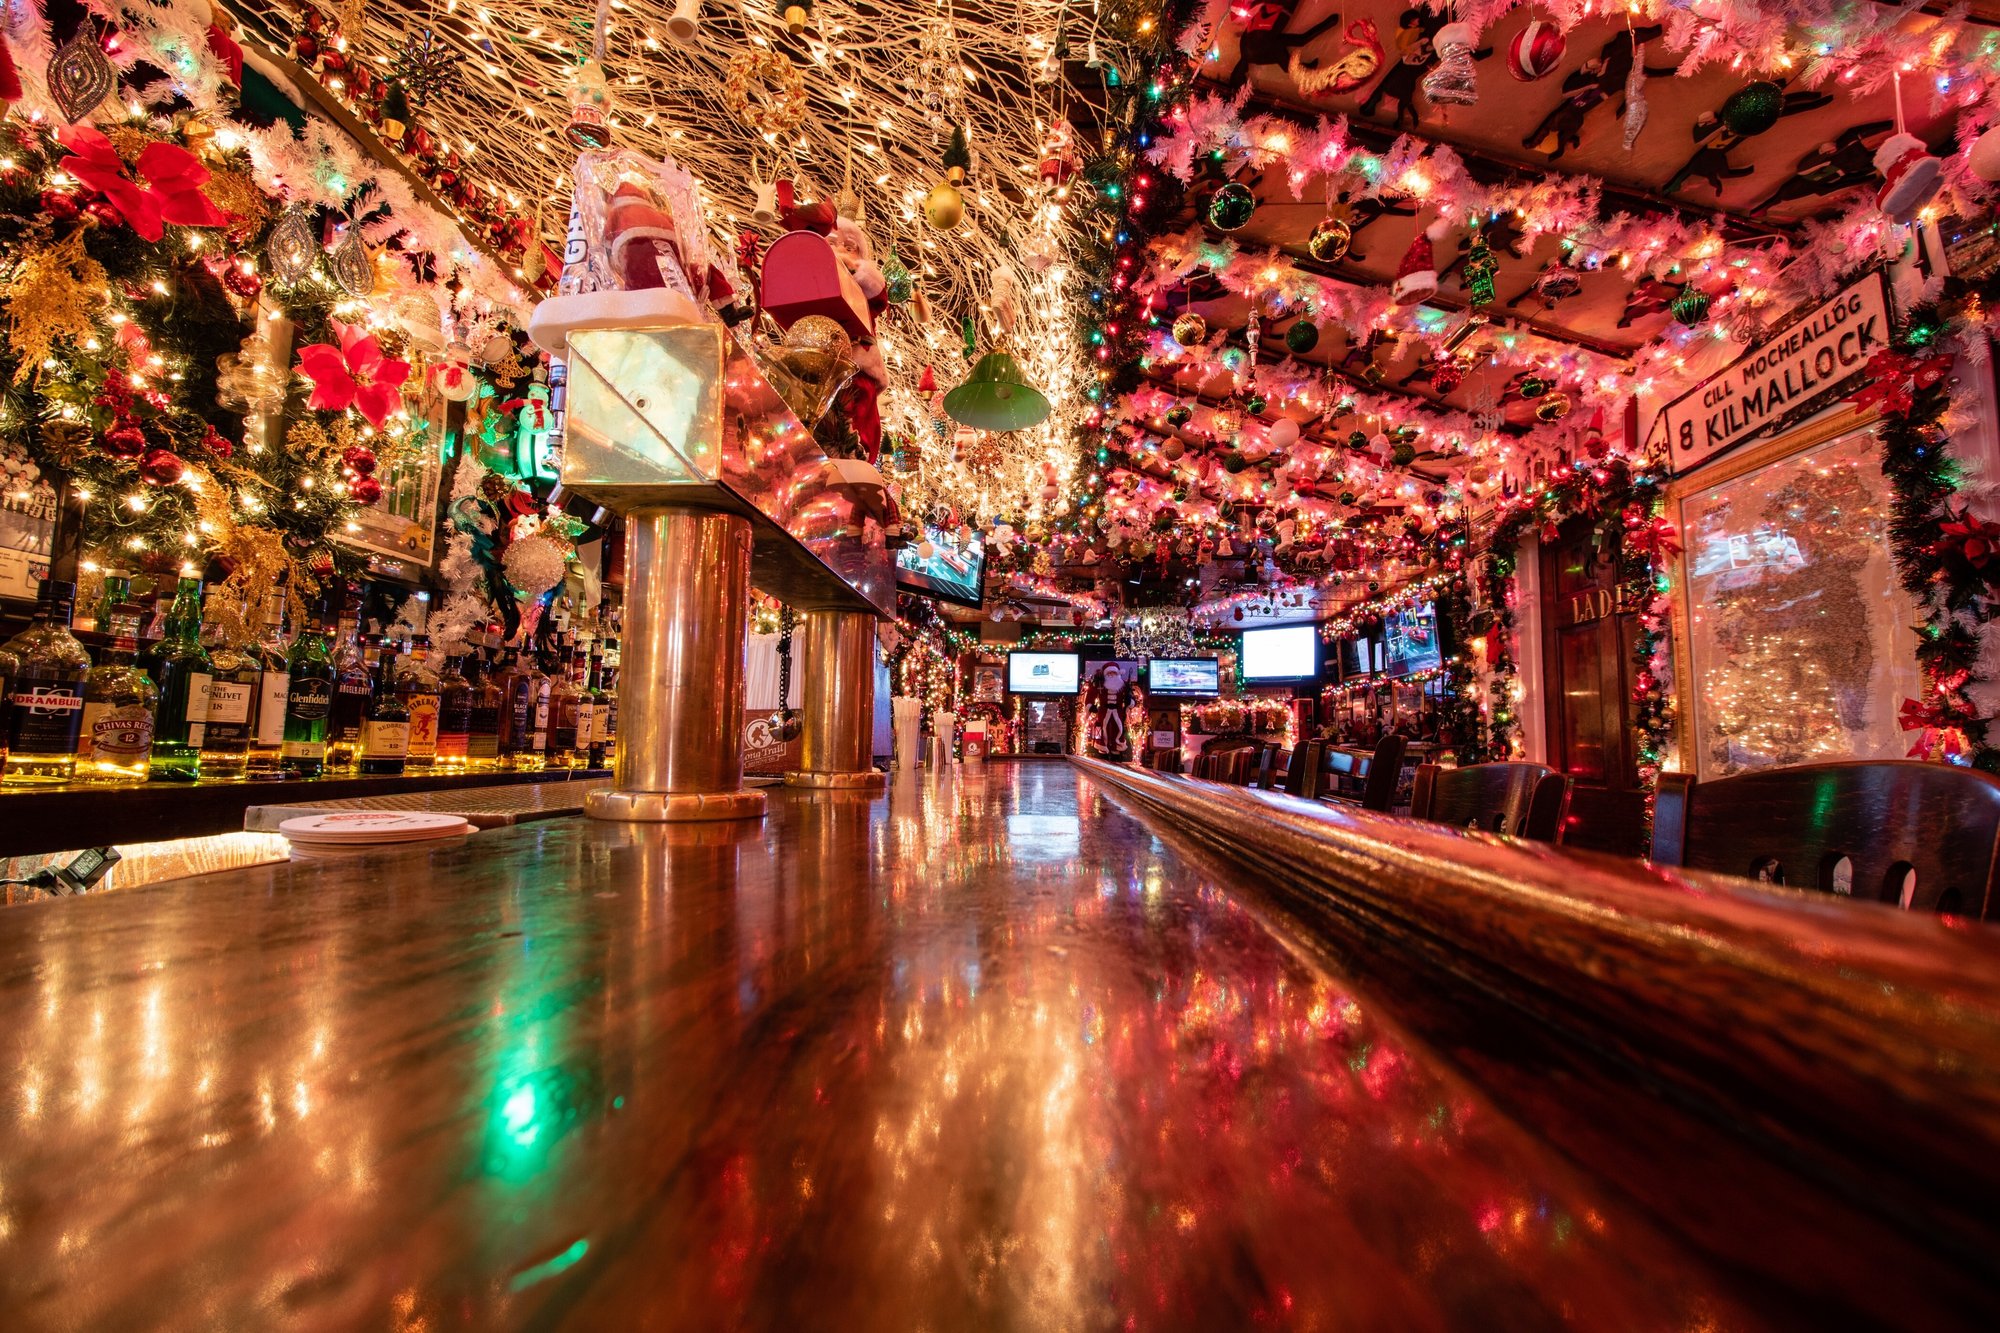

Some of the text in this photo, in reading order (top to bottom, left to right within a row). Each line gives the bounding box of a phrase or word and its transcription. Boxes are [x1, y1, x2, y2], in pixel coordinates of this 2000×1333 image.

[1679, 314, 1878, 451] 8 KILMALLOCK
[1703, 380, 1734, 409] CILL
[16, 695, 81, 707] DRAMBUIE
[95, 721, 132, 732] CHIVAS
[125, 734, 135, 742] 12
[301, 748, 310, 756] 12
